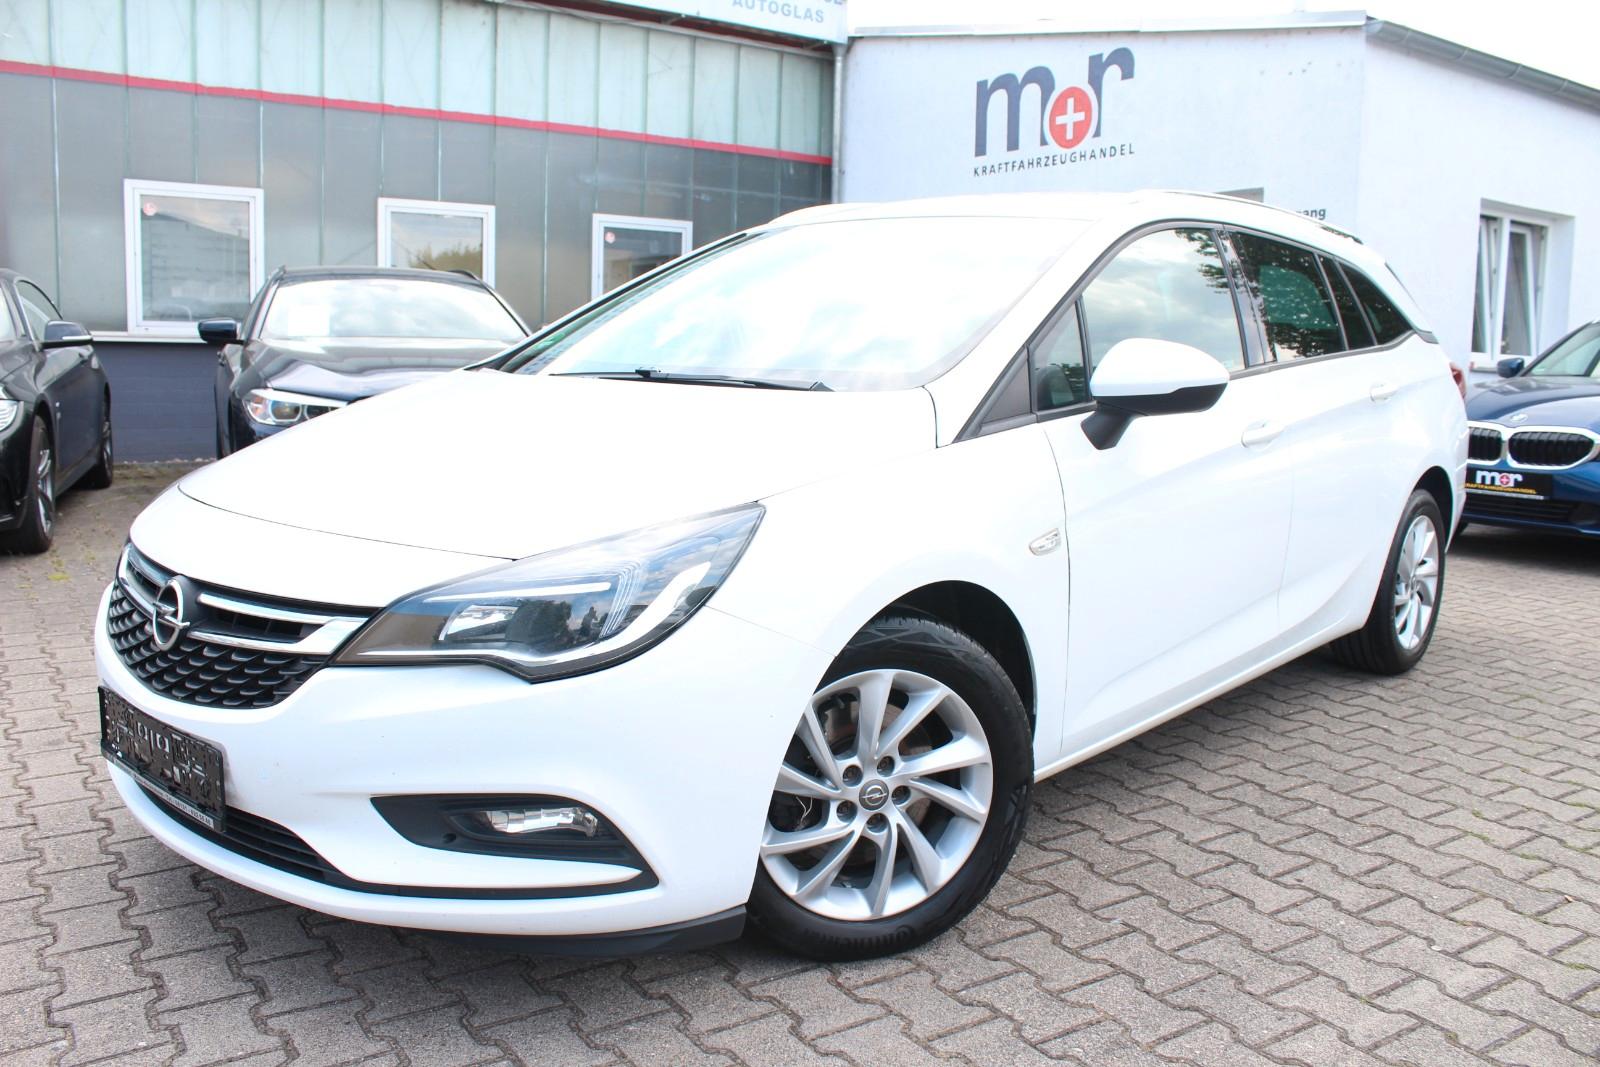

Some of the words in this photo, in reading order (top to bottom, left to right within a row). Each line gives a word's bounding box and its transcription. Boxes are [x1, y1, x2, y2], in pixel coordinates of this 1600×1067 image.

[731, 0, 825, 23] AUTOGLAS
[973, 143, 1135, 177] KRAFTFAHRZEUGHANDEL
[1296, 208, 1326, 220] ang
